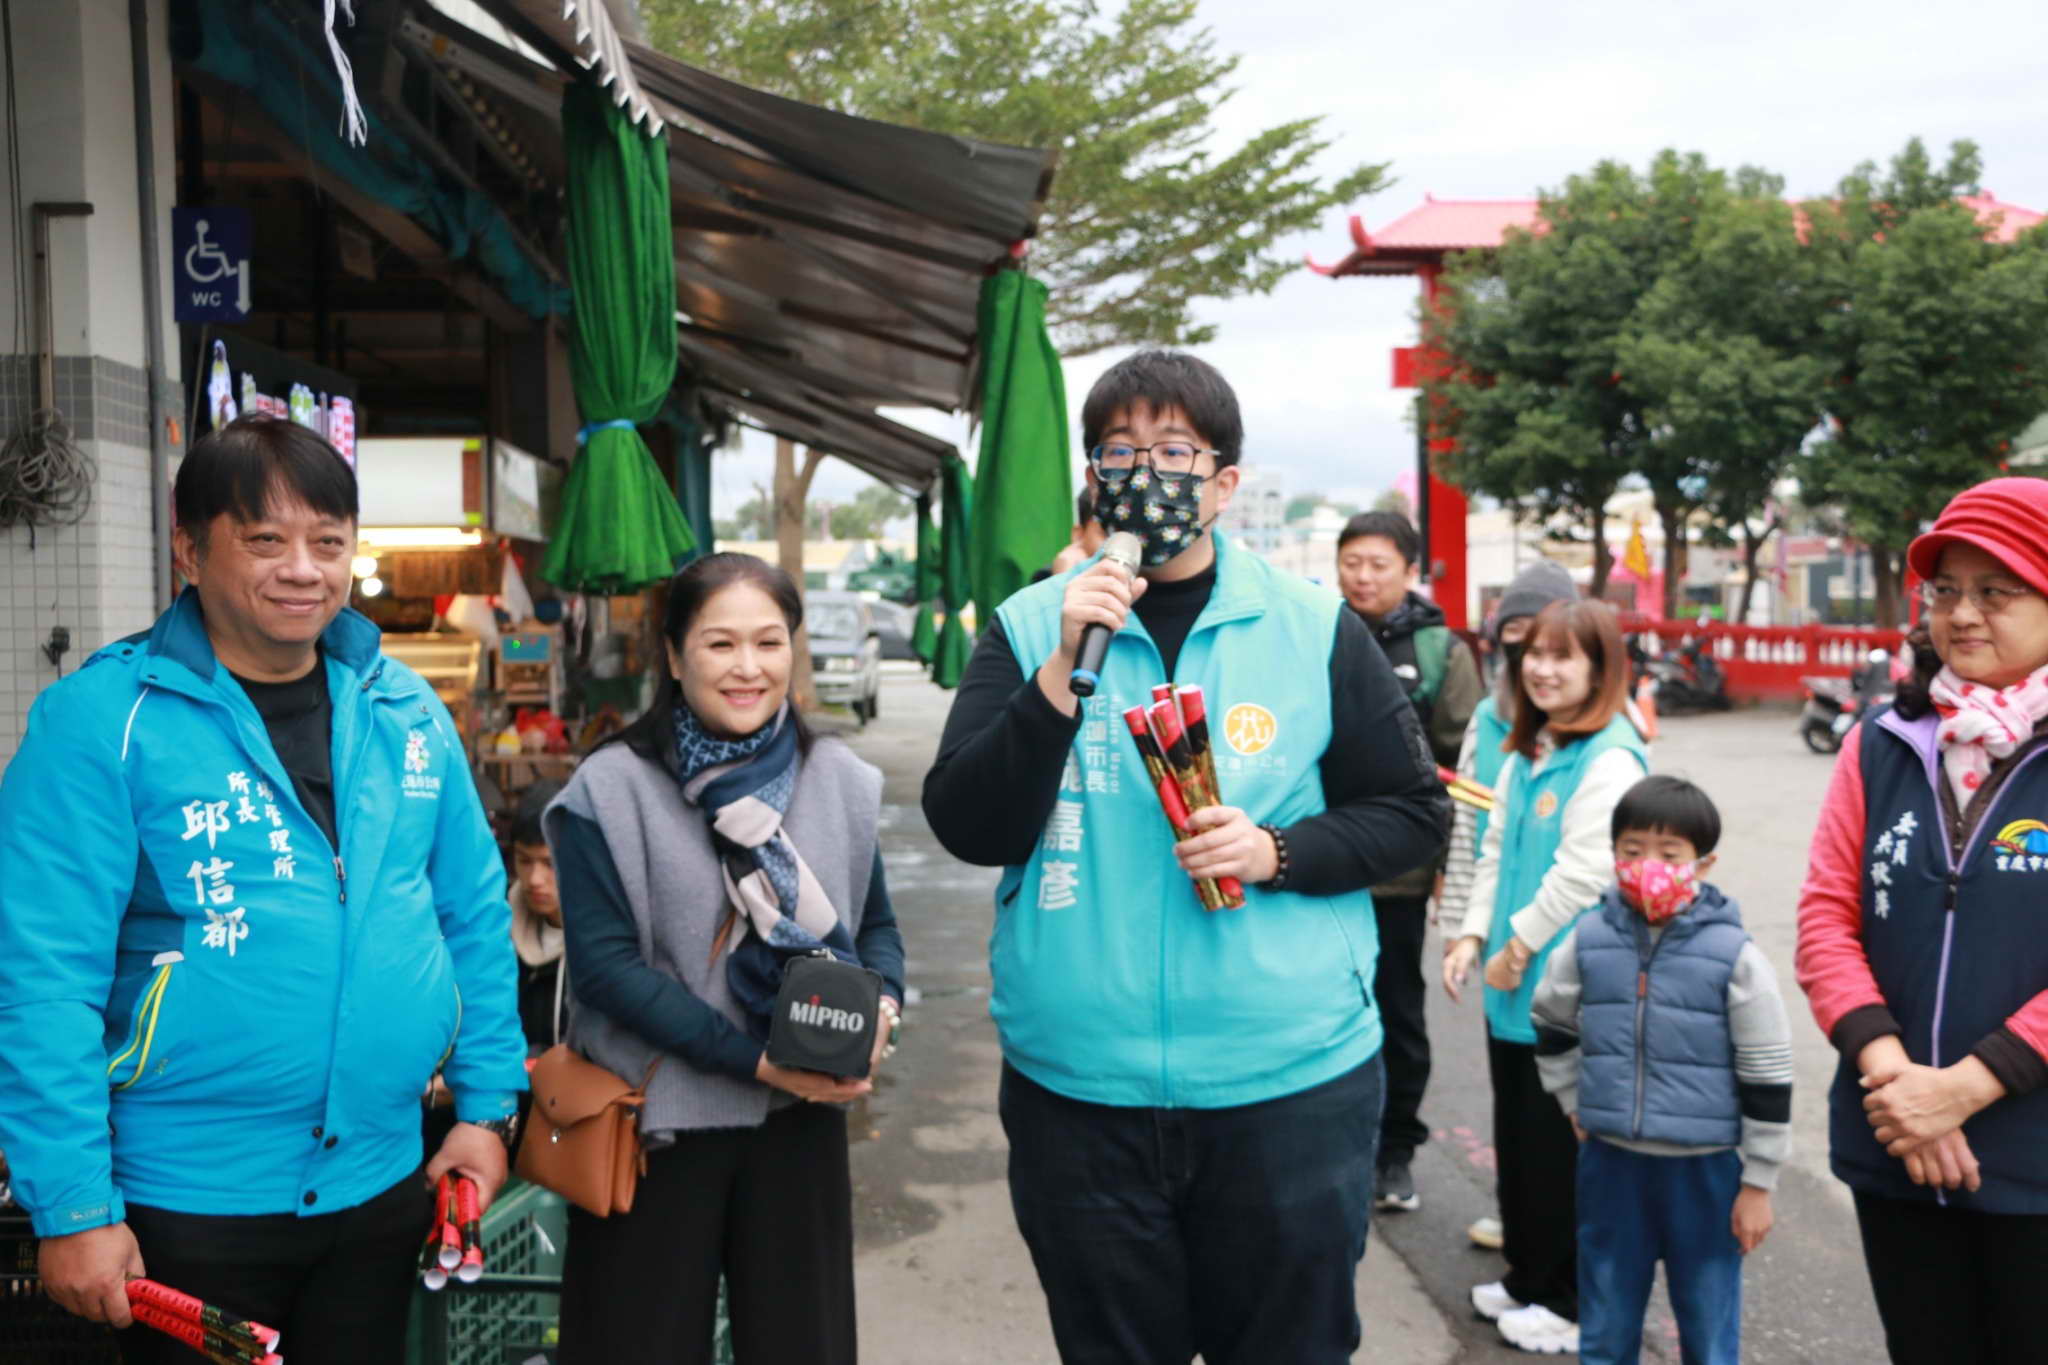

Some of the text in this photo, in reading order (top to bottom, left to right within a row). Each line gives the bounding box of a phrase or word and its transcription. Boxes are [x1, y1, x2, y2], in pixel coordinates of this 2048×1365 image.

[192, 291, 222, 307] WC
[227, 771, 260, 824] 所長
[181, 800, 250, 957] 邱信都
[789, 994, 865, 1034] MIPRO
